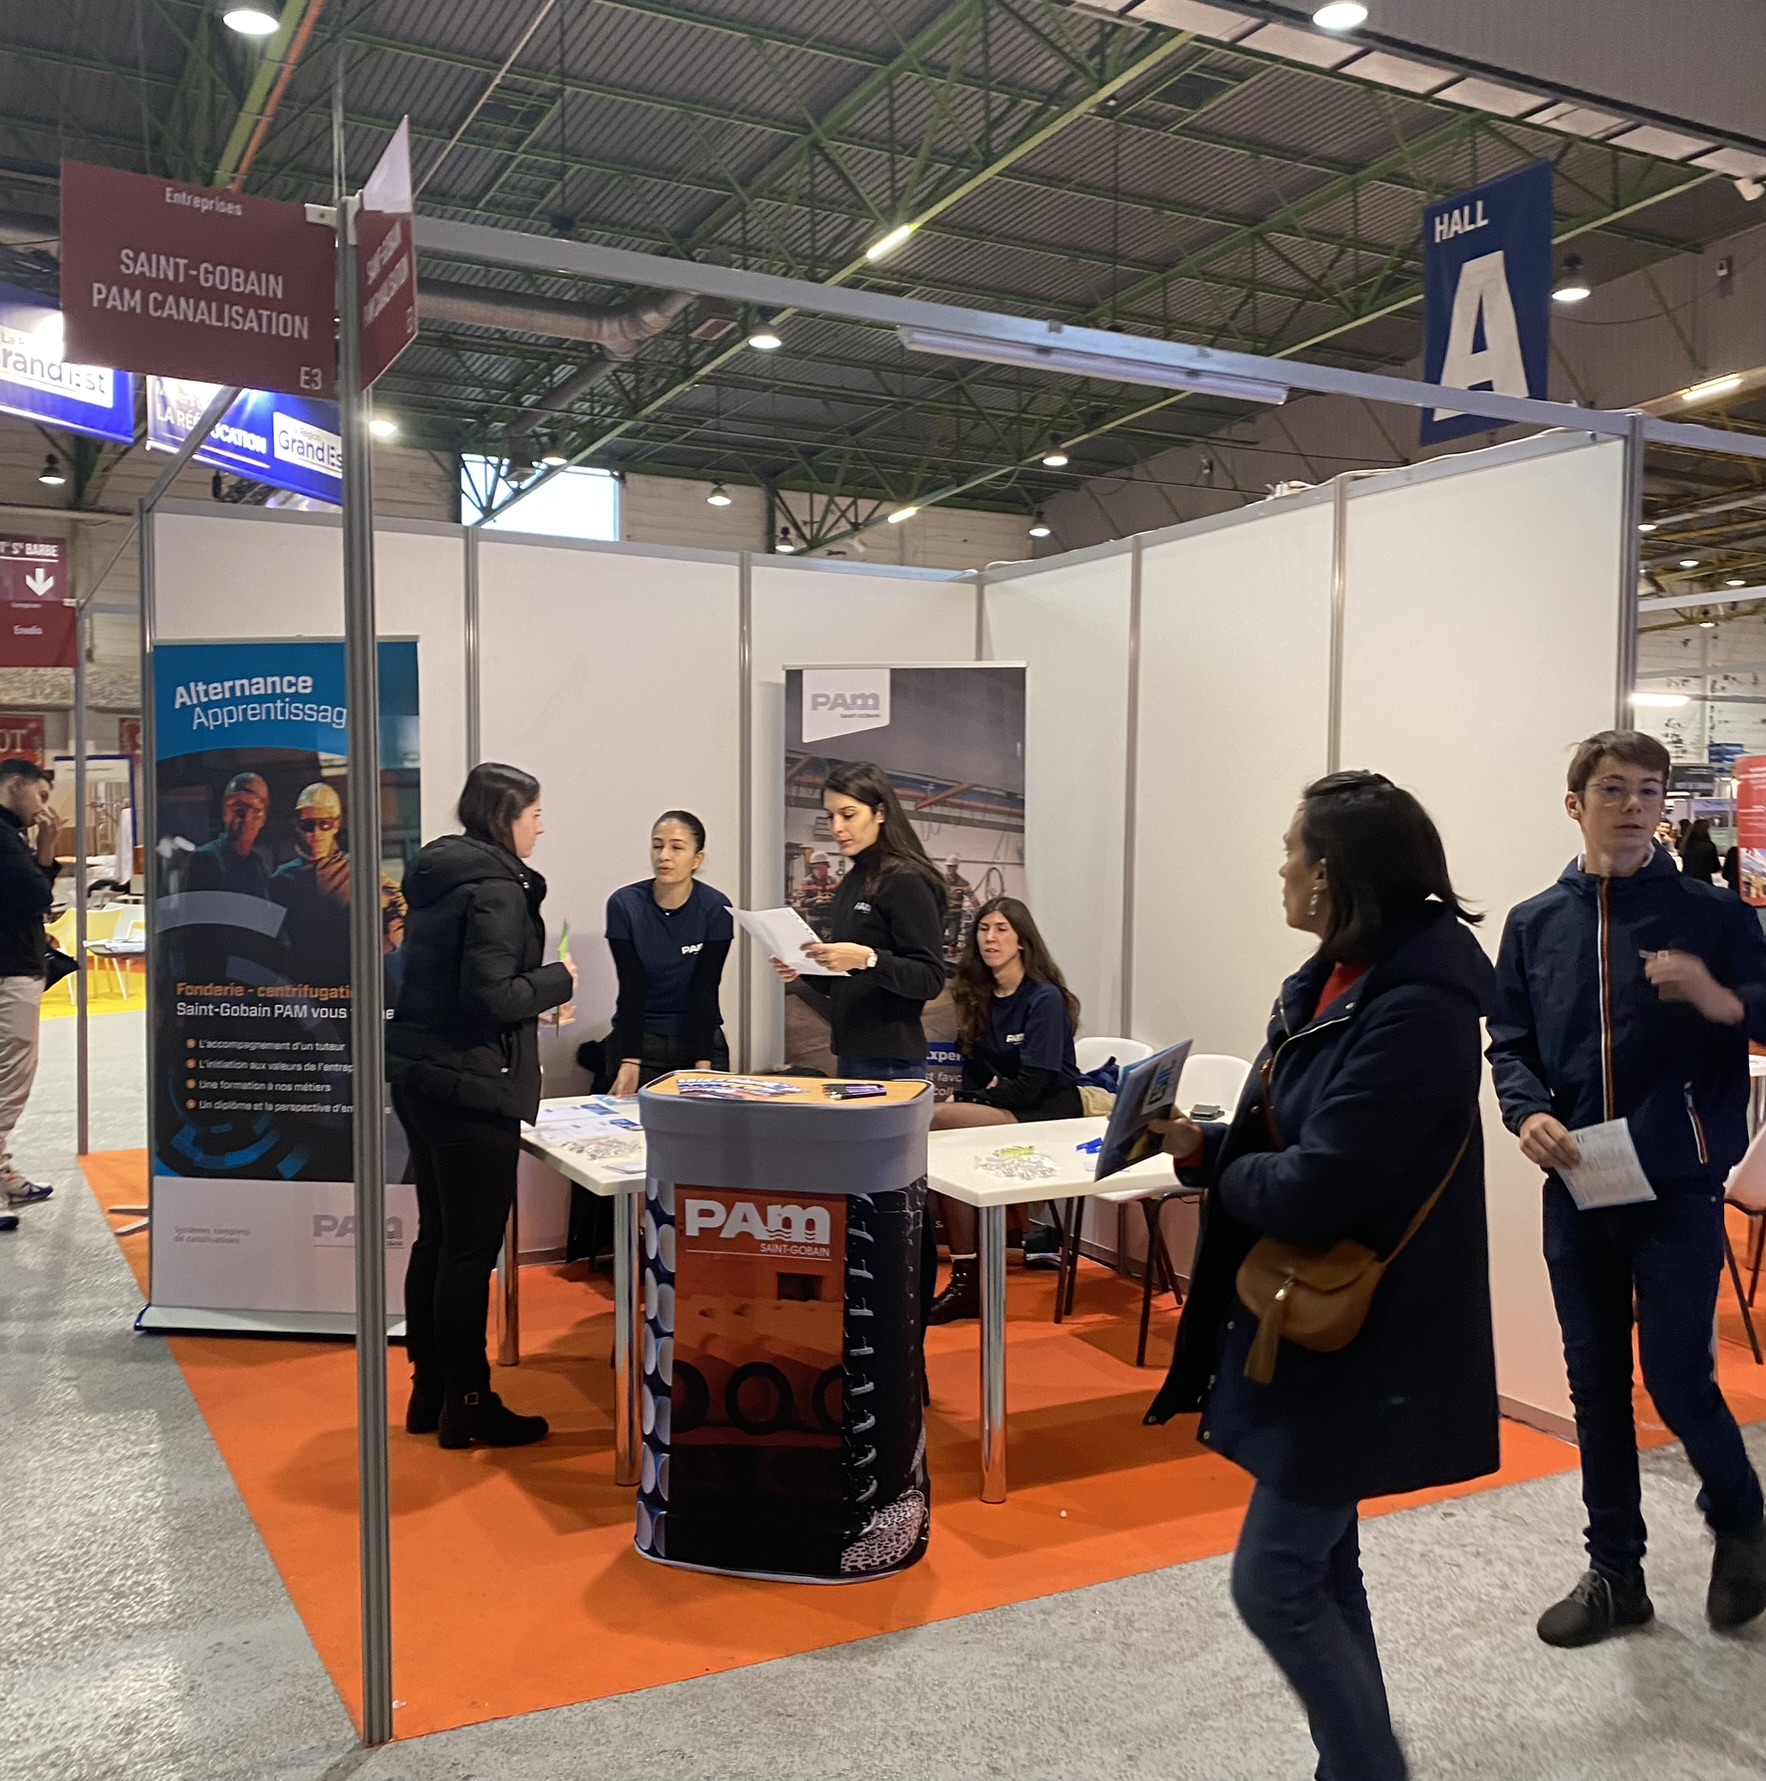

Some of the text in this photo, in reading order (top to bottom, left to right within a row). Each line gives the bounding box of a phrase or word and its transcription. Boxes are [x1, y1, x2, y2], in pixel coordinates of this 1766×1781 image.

[165, 187, 243, 216] Entreprises
[1434, 200, 1490, 243] HALL
[120, 248, 283, 299] SAINT-GOBAIN
[92, 286, 309, 340] PAM CANALISATION
[1433, 250, 1530, 422] A
[0, 347, 106, 394] randEst
[300, 366, 322, 391] E3
[156, 404, 268, 455] LA RÉÉUCATION
[278, 429, 343, 469] GrandEs
[173, 675, 313, 709] Alternance
[192, 698, 347, 730] Apprentissag
[176, 982, 245, 996] Fonderie
[256, 983, 352, 1001] centrifugati
[176, 1002, 271, 1017] Saint-Gobain
[274, 1004, 308, 1018] PAM
[310, 1007, 348, 1019] vous
[199, 1040, 345, 1051] L'accompagnement d'un tuteur
[249, 1062, 267, 1070] aux
[268, 1062, 302, 1071] valeurs
[303, 1062, 317, 1071] de
[318, 1062, 353, 1073] l'entrep
[199, 1080, 218, 1089] Une
[220, 1080, 266, 1090] formation
[275, 1083, 293, 1091] nos
[294, 1082, 332, 1092] métiers
[199, 1100, 213, 1109] Un
[214, 1100, 252, 1111] diplôme
[253, 1102, 263, 1111] et
[274, 1102, 331, 1113] perspective
[760, 1243, 830, 1257] SAINT-GOBAIN
